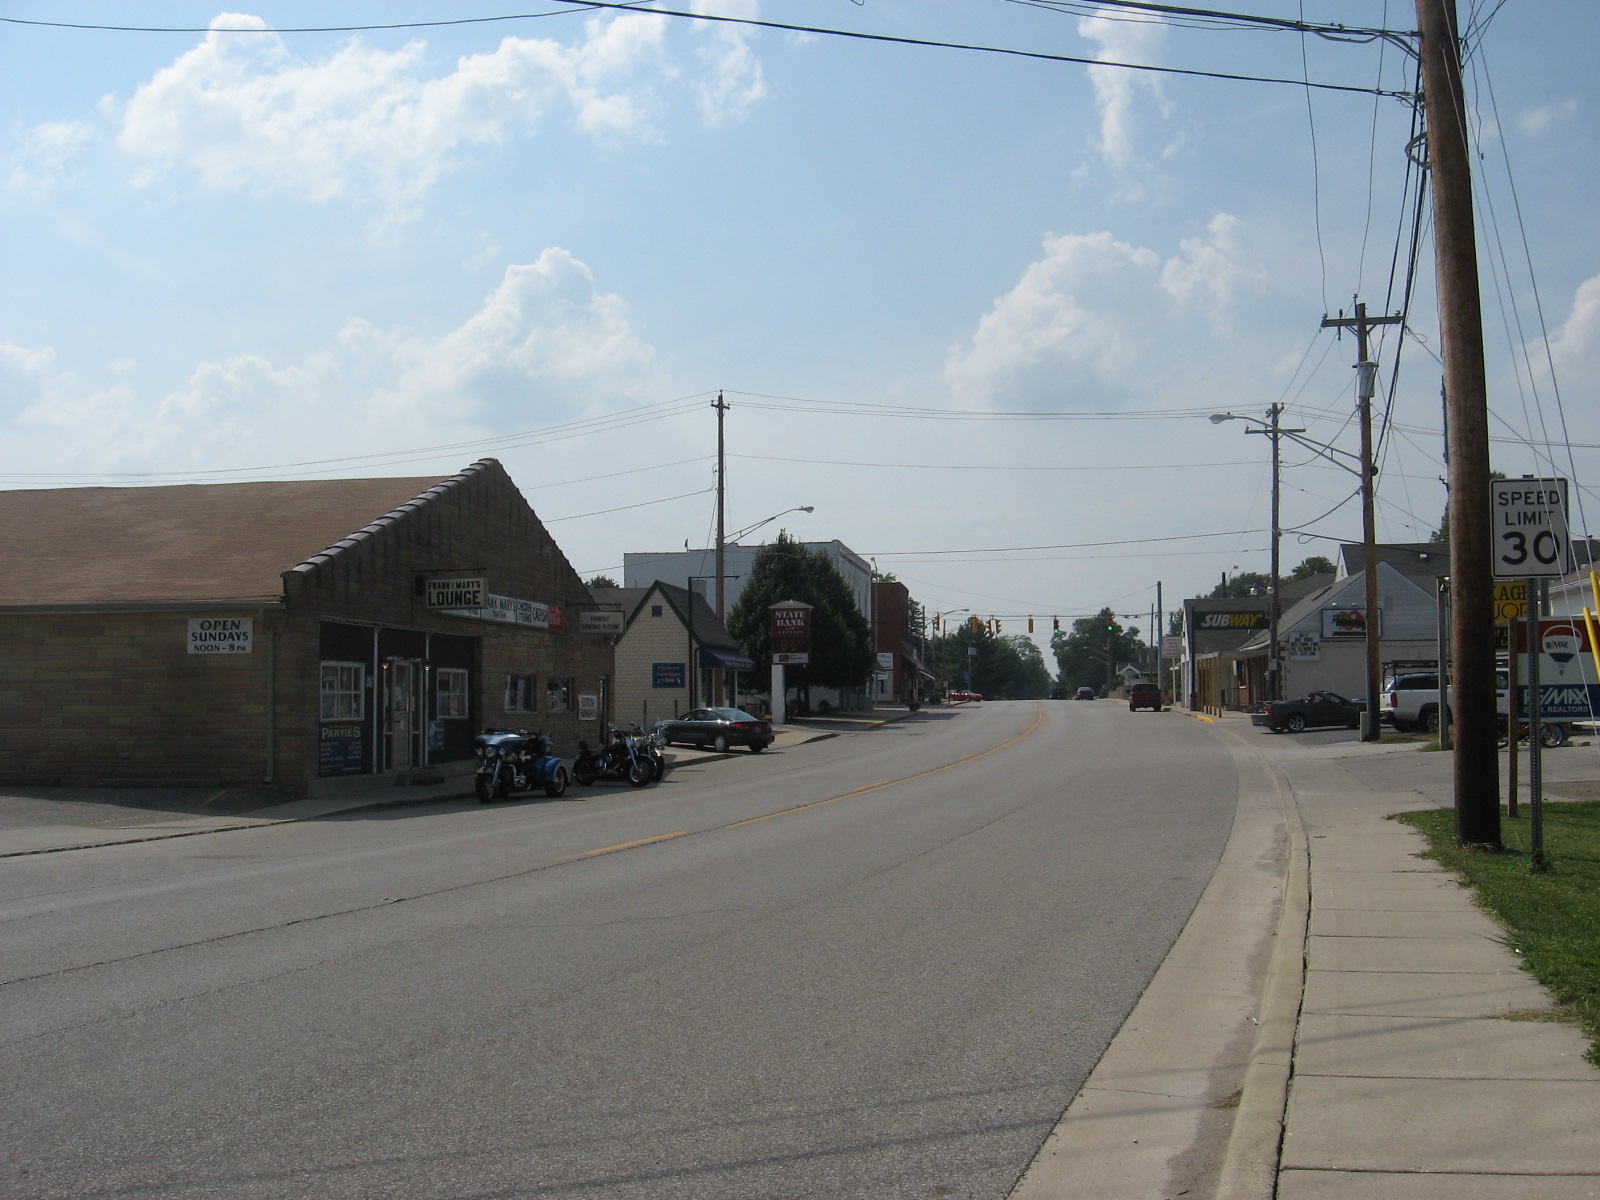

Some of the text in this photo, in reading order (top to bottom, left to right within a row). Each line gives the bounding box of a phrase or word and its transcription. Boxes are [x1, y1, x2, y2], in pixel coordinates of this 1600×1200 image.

[1498, 490, 1561, 506] SPEED
[1505, 510, 1554, 526] LIMIT
[1501, 530, 1560, 565] 30
[427, 581, 450, 590] FRANK
[455, 580, 481, 589] MARY'S
[427, 590, 481, 607] LOUNGE
[775, 610, 806, 618] STATE
[1200, 613, 1264, 627] SUBWAY
[199, 619, 241, 631] OPEN
[191, 631, 249, 642] SUNDAYS
[193, 644, 220, 652] NOON
[228, 643, 235, 652] 8
[1545, 641, 1569, 649] RE/MAX
[1547, 705, 1589, 713] REALTORS
[321, 726, 362, 739] PARTIES
